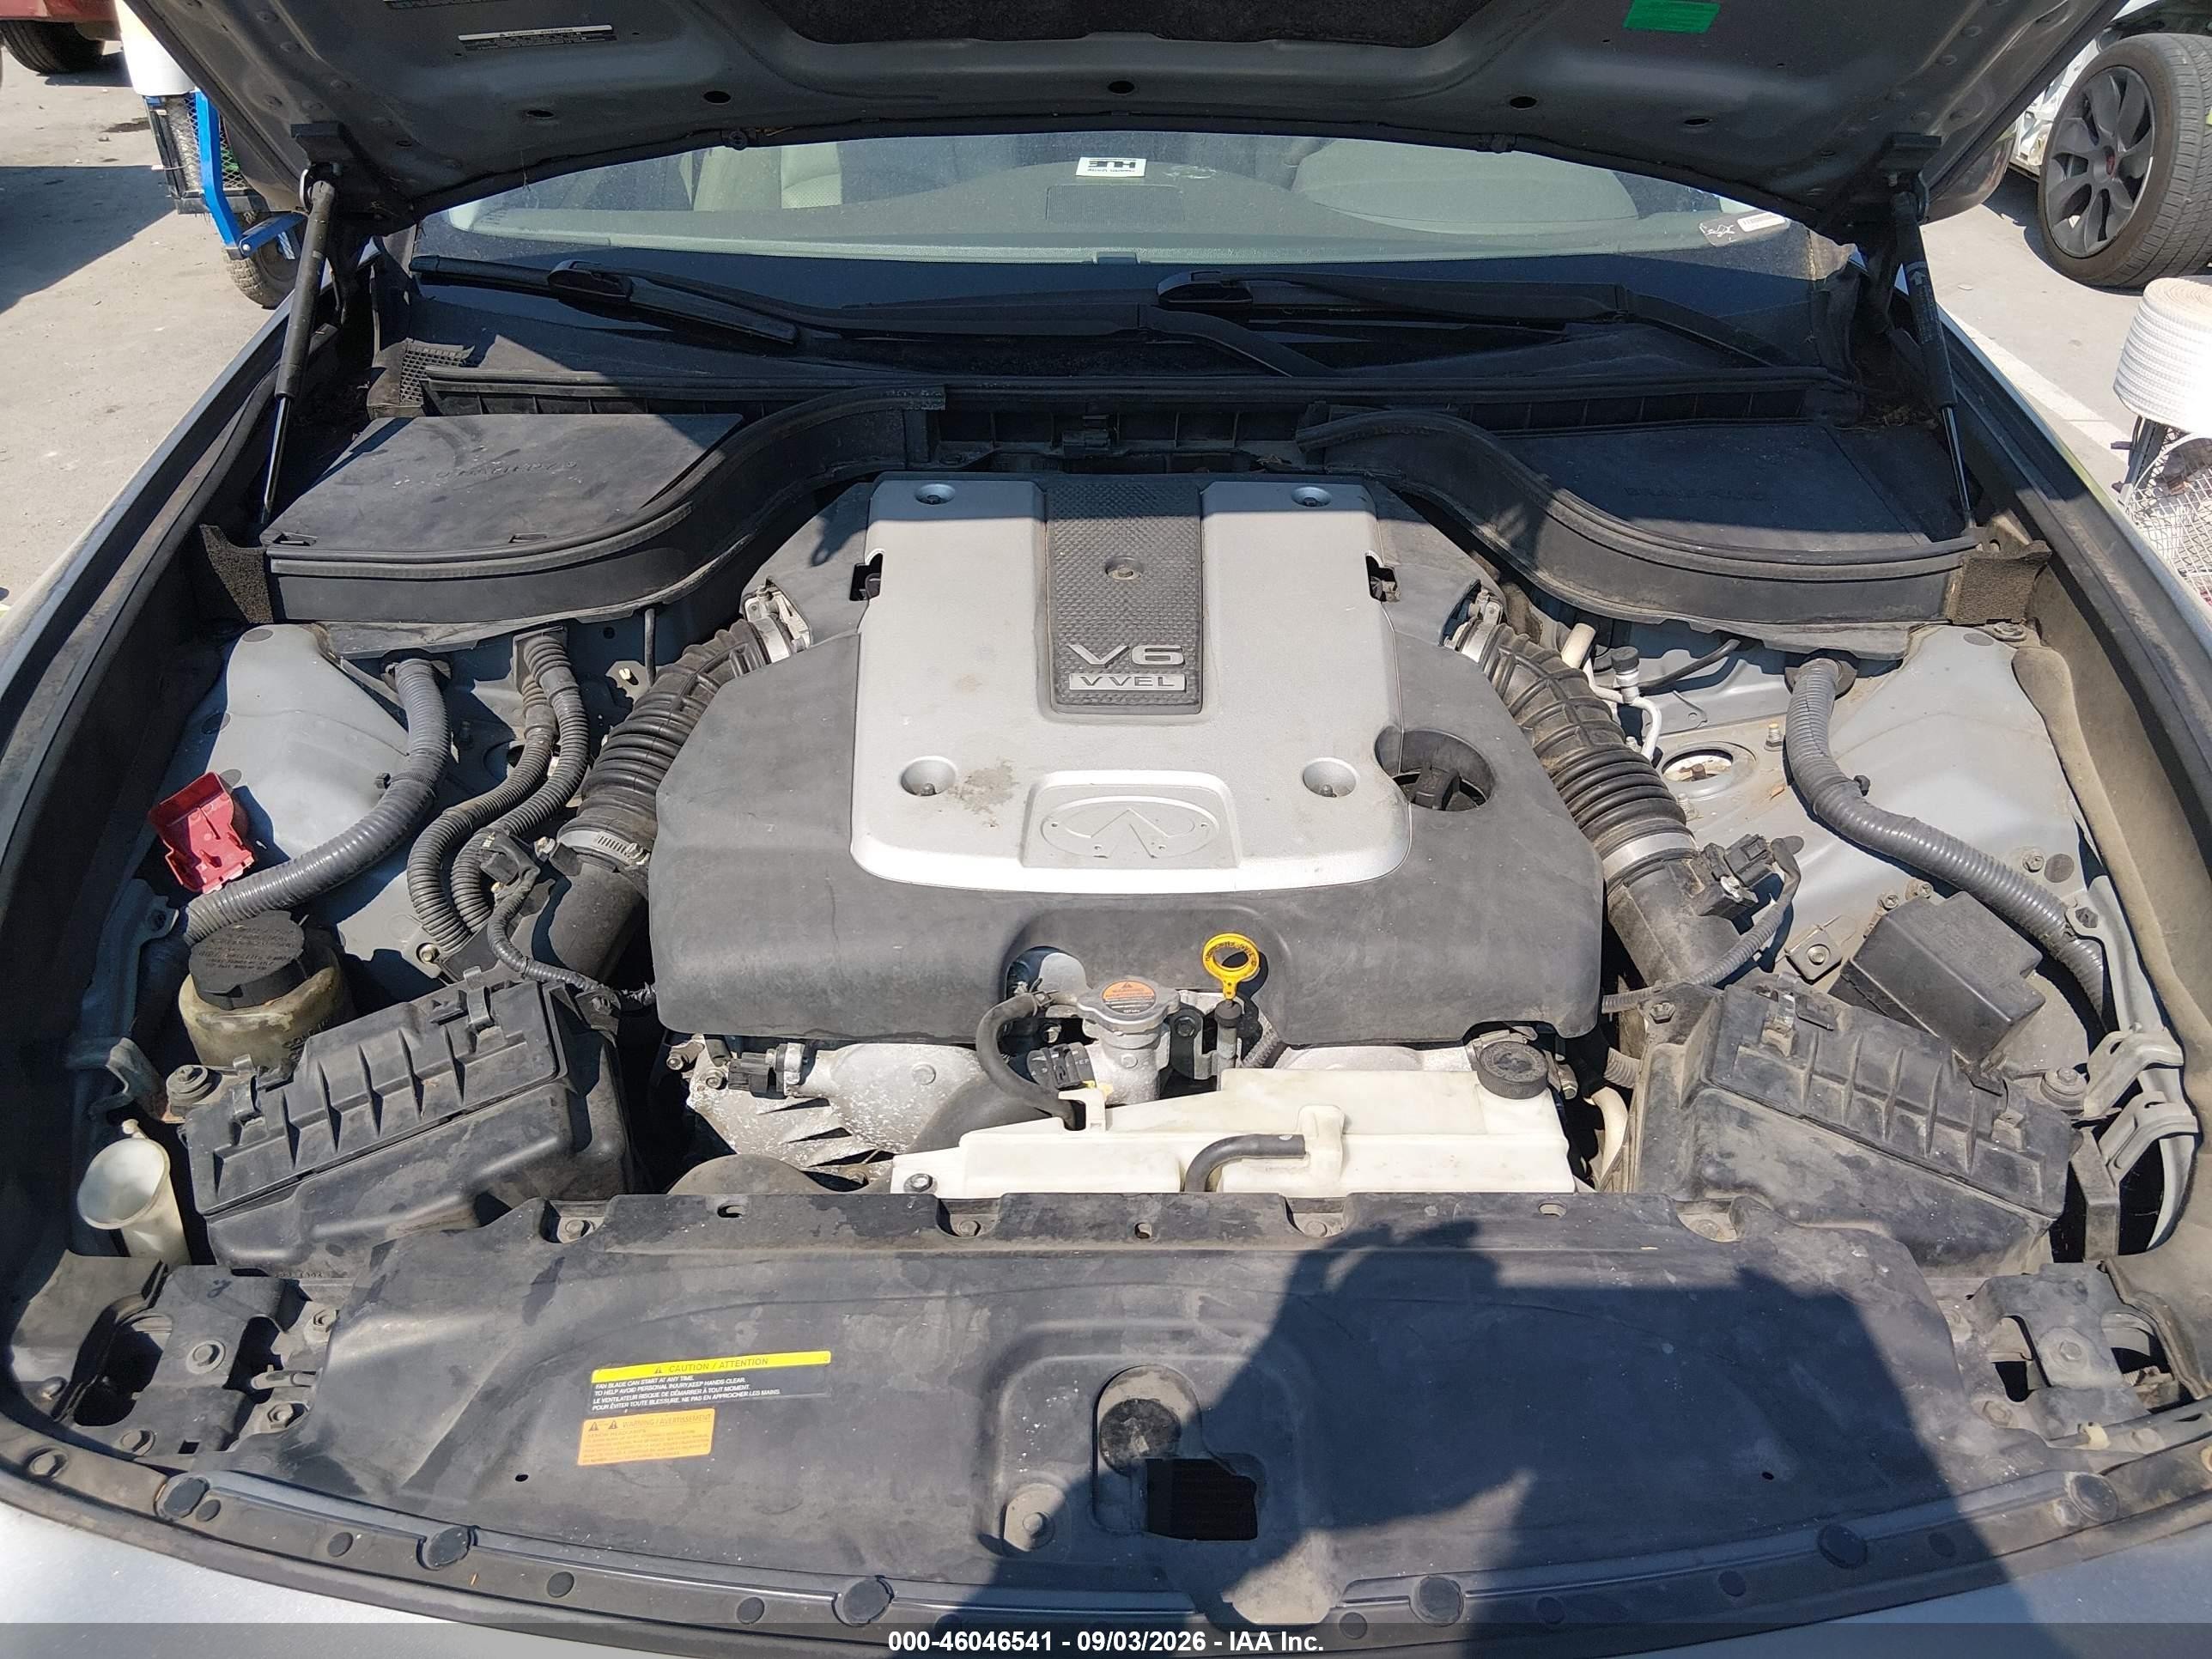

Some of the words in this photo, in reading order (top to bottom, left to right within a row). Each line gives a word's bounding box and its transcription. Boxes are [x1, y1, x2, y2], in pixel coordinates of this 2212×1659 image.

[1067, 644, 1186, 666] V6
[1079, 676, 1176, 687] VVEL
[669, 1364, 708, 1373] CAUTION
[719, 1358, 769, 1370] ATTENTION
[602, 1395, 637, 1403] VENTILATEUR
[712, 1389, 749, 1399] APPROCHER
[622, 1418, 654, 1428] WARNING
[659, 1413, 712, 1425] AVERTISSEMENT
